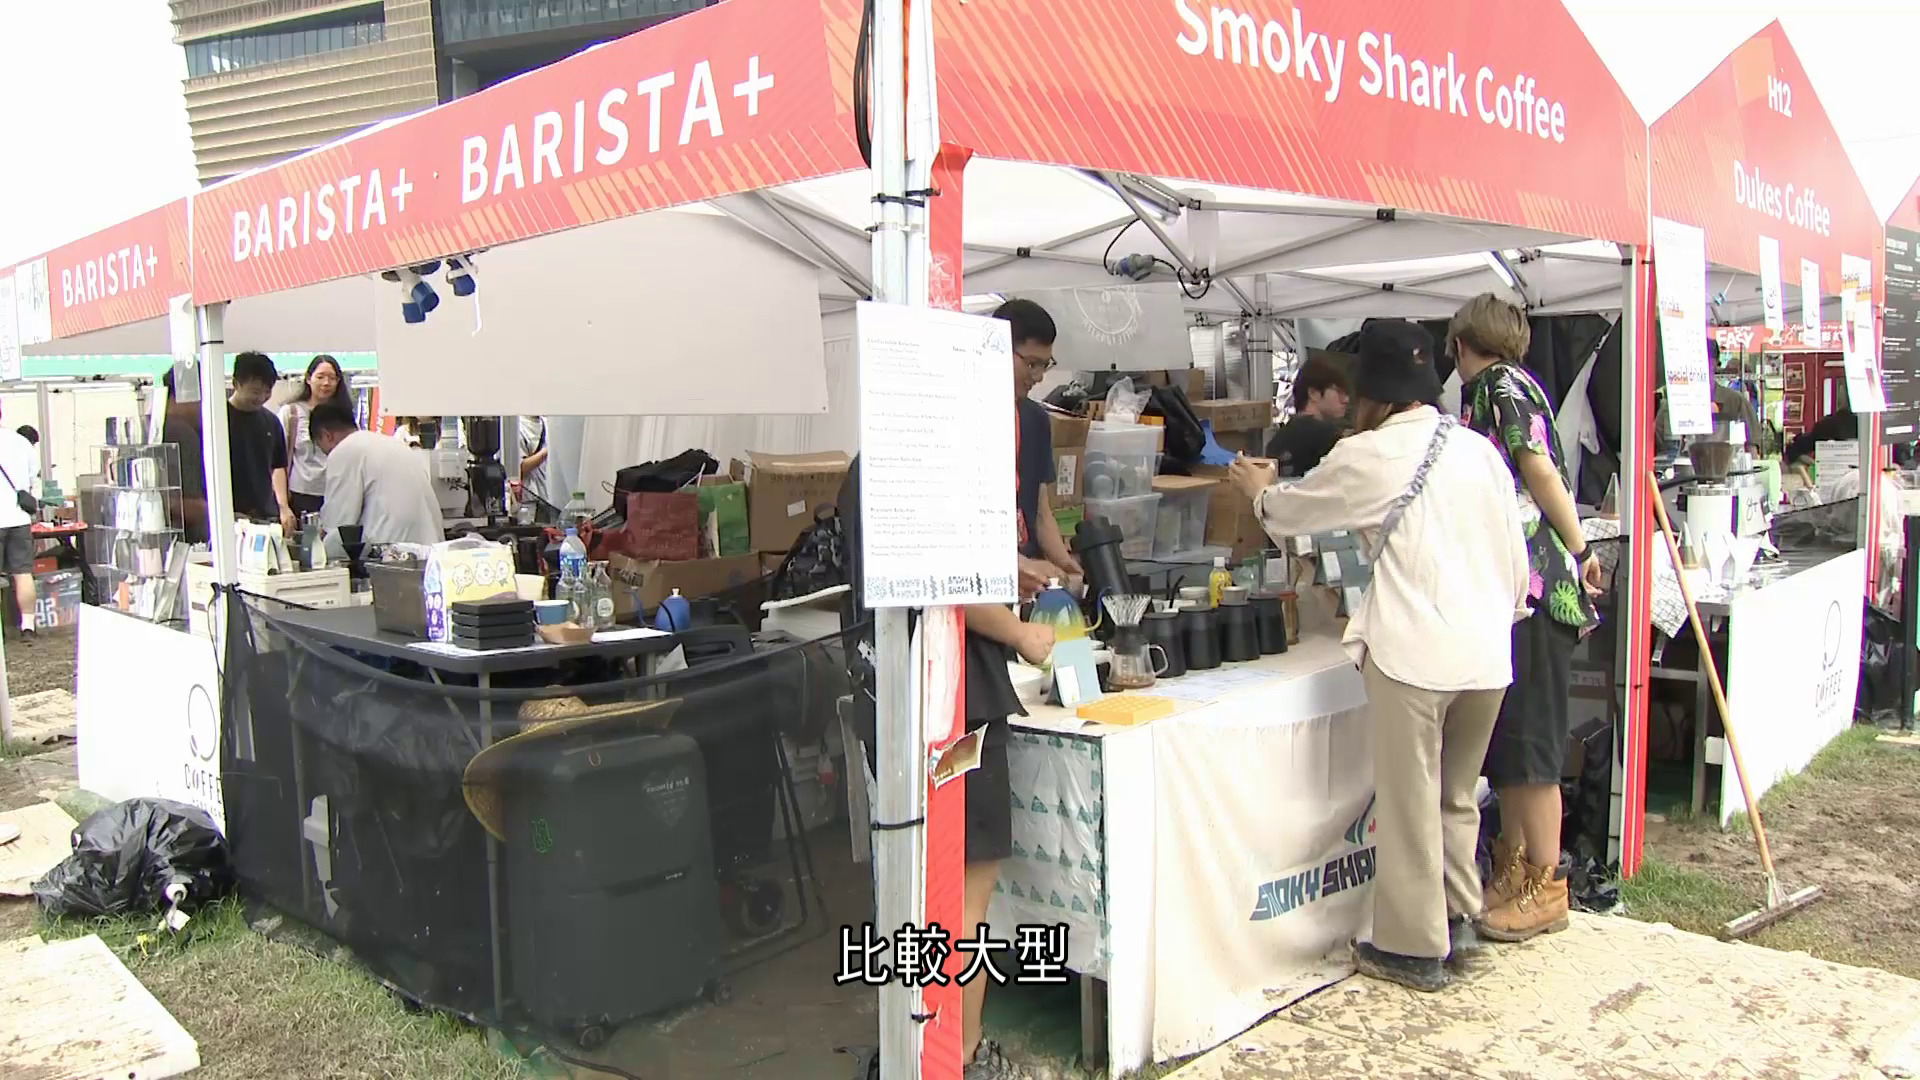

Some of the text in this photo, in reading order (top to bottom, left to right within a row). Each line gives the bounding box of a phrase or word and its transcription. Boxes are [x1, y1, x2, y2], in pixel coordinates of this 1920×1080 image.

[1176, 0, 1566, 144] Smoky Shark Coffee
[1767, 75, 1792, 118] H12
[461, 56, 776, 204] BARISTA+
[233, 168, 414, 263] BARISTA+
[1734, 159, 1830, 237] Dukes Coffee
[62, 244, 159, 308] BARISTA+
[1815, 669, 1842, 707] COFFEE
[185, 763, 221, 804] COFFE
